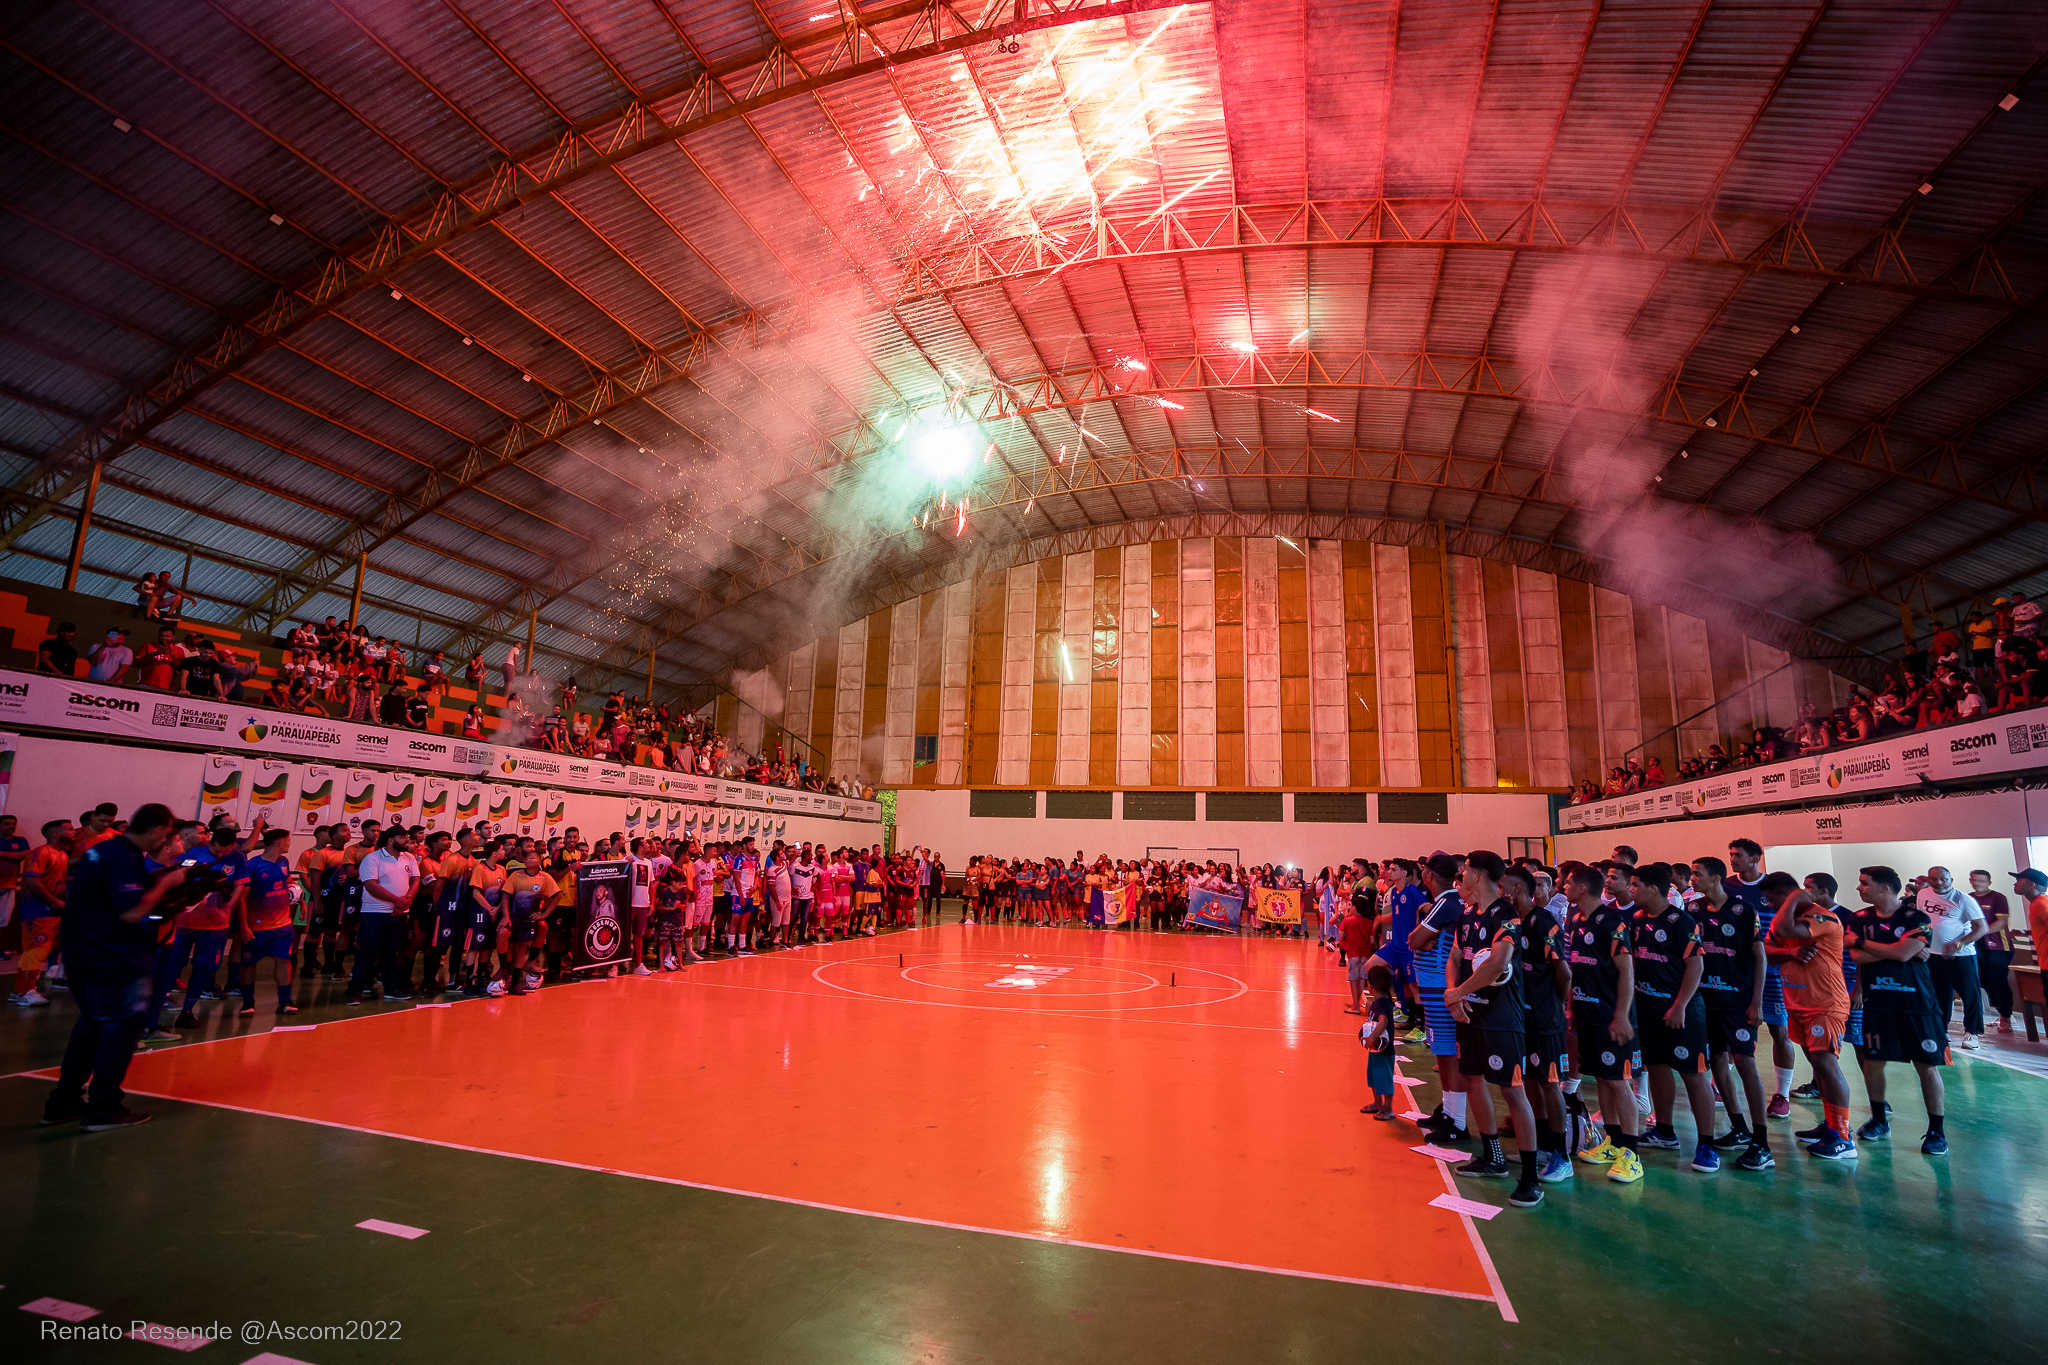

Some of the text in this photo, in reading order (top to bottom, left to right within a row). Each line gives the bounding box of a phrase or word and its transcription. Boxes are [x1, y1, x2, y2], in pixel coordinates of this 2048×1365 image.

[68, 692, 140, 713] ascom
[65, 711, 111, 721] Comunicação
[182, 708, 217, 719] SIGA-NOS
[180, 715, 227, 727] INSTAGRAM
[278, 721, 324, 730] PREFEITURA
[271, 725, 341, 744] PARAUAPEBAS
[356, 733, 389, 745] semel
[408, 740, 447, 753] ascom
[1950, 732, 1997, 752] ascom
[1901, 742, 1930, 761] semel
[519, 760, 560, 773] PARAUAPEBAS
[1843, 757, 1891, 777] PARAUAPEBAS
[1952, 756, 1981, 766] Comunicação
[569, 764, 589, 773] semel
[601, 768, 626, 778] ascom
[1737, 776, 1752, 788] semel
[1761, 772, 1785, 785] ascom
[670, 780, 699, 791] PARAUAPEBAS
[1815, 813, 1842, 829] semel
[349, 886, 356, 895] 8
[427, 903, 433, 912] 7
[448, 901, 457, 911] 14
[1924, 900, 1946, 916] LOST
[476, 913, 483, 923] 11
[589, 919, 617, 934] RESENDE
[1708, 975, 1727, 985] KL
[1876, 976, 1901, 985] KL
[1775, 1003, 1781, 1015] 8
[1865, 1033, 1881, 1050] 11
